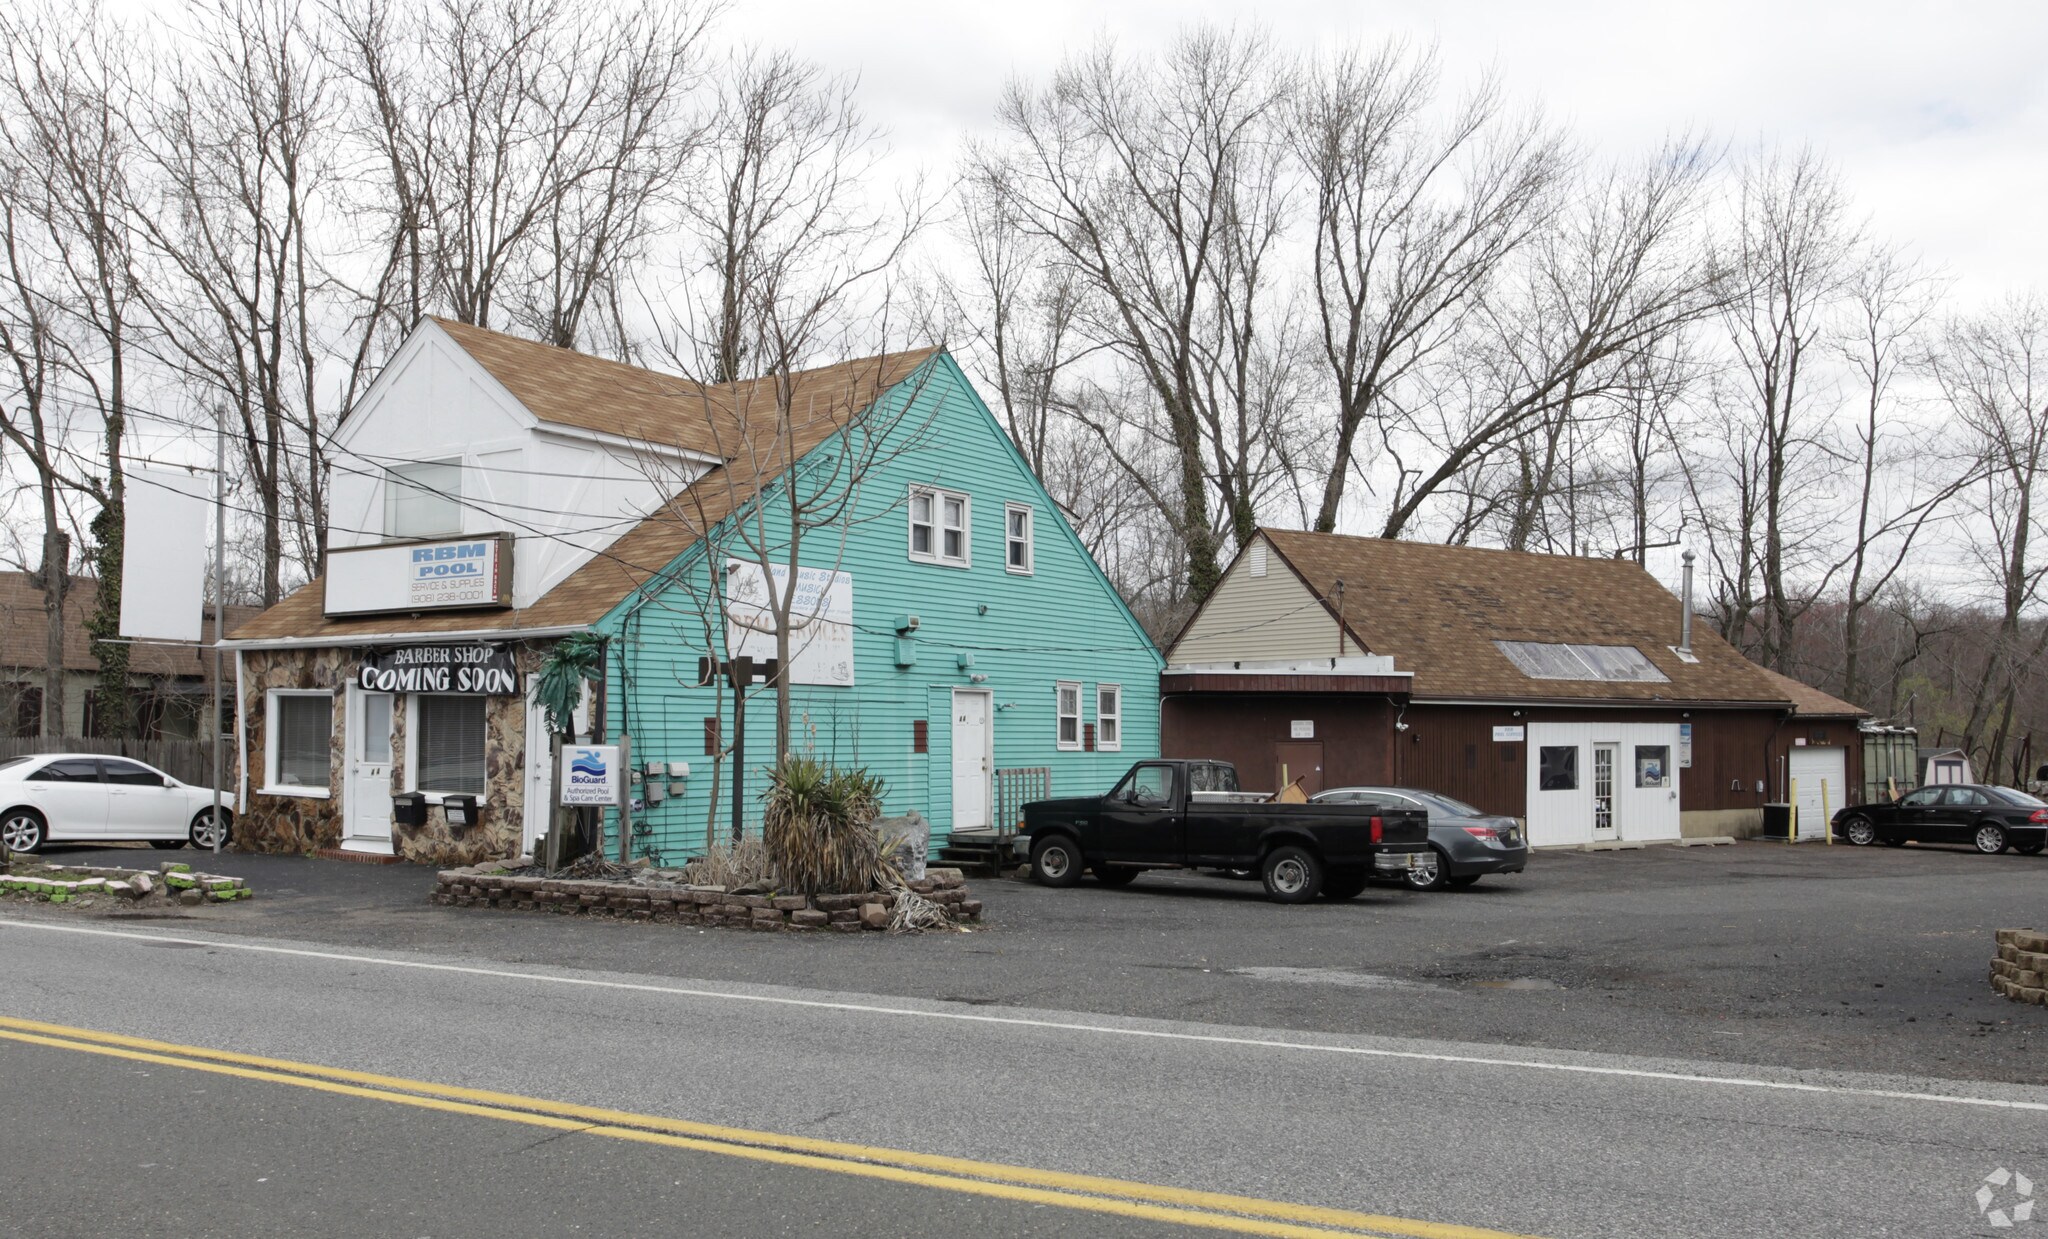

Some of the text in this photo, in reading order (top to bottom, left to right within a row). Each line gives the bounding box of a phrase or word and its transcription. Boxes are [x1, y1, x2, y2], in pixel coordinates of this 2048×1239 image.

[412, 543, 486, 563] RBM
[419, 562, 477, 577] POOL
[411, 577, 485, 592] SERVICE & SUPPLIES
[411, 591, 484, 604] (908) 238-0001
[394, 646, 494, 665] BARBER SHOP
[361, 666, 515, 693] COMING SOON
[571, 776, 606, 784] BioGuard
[567, 787, 610, 795] Authorized Pool
